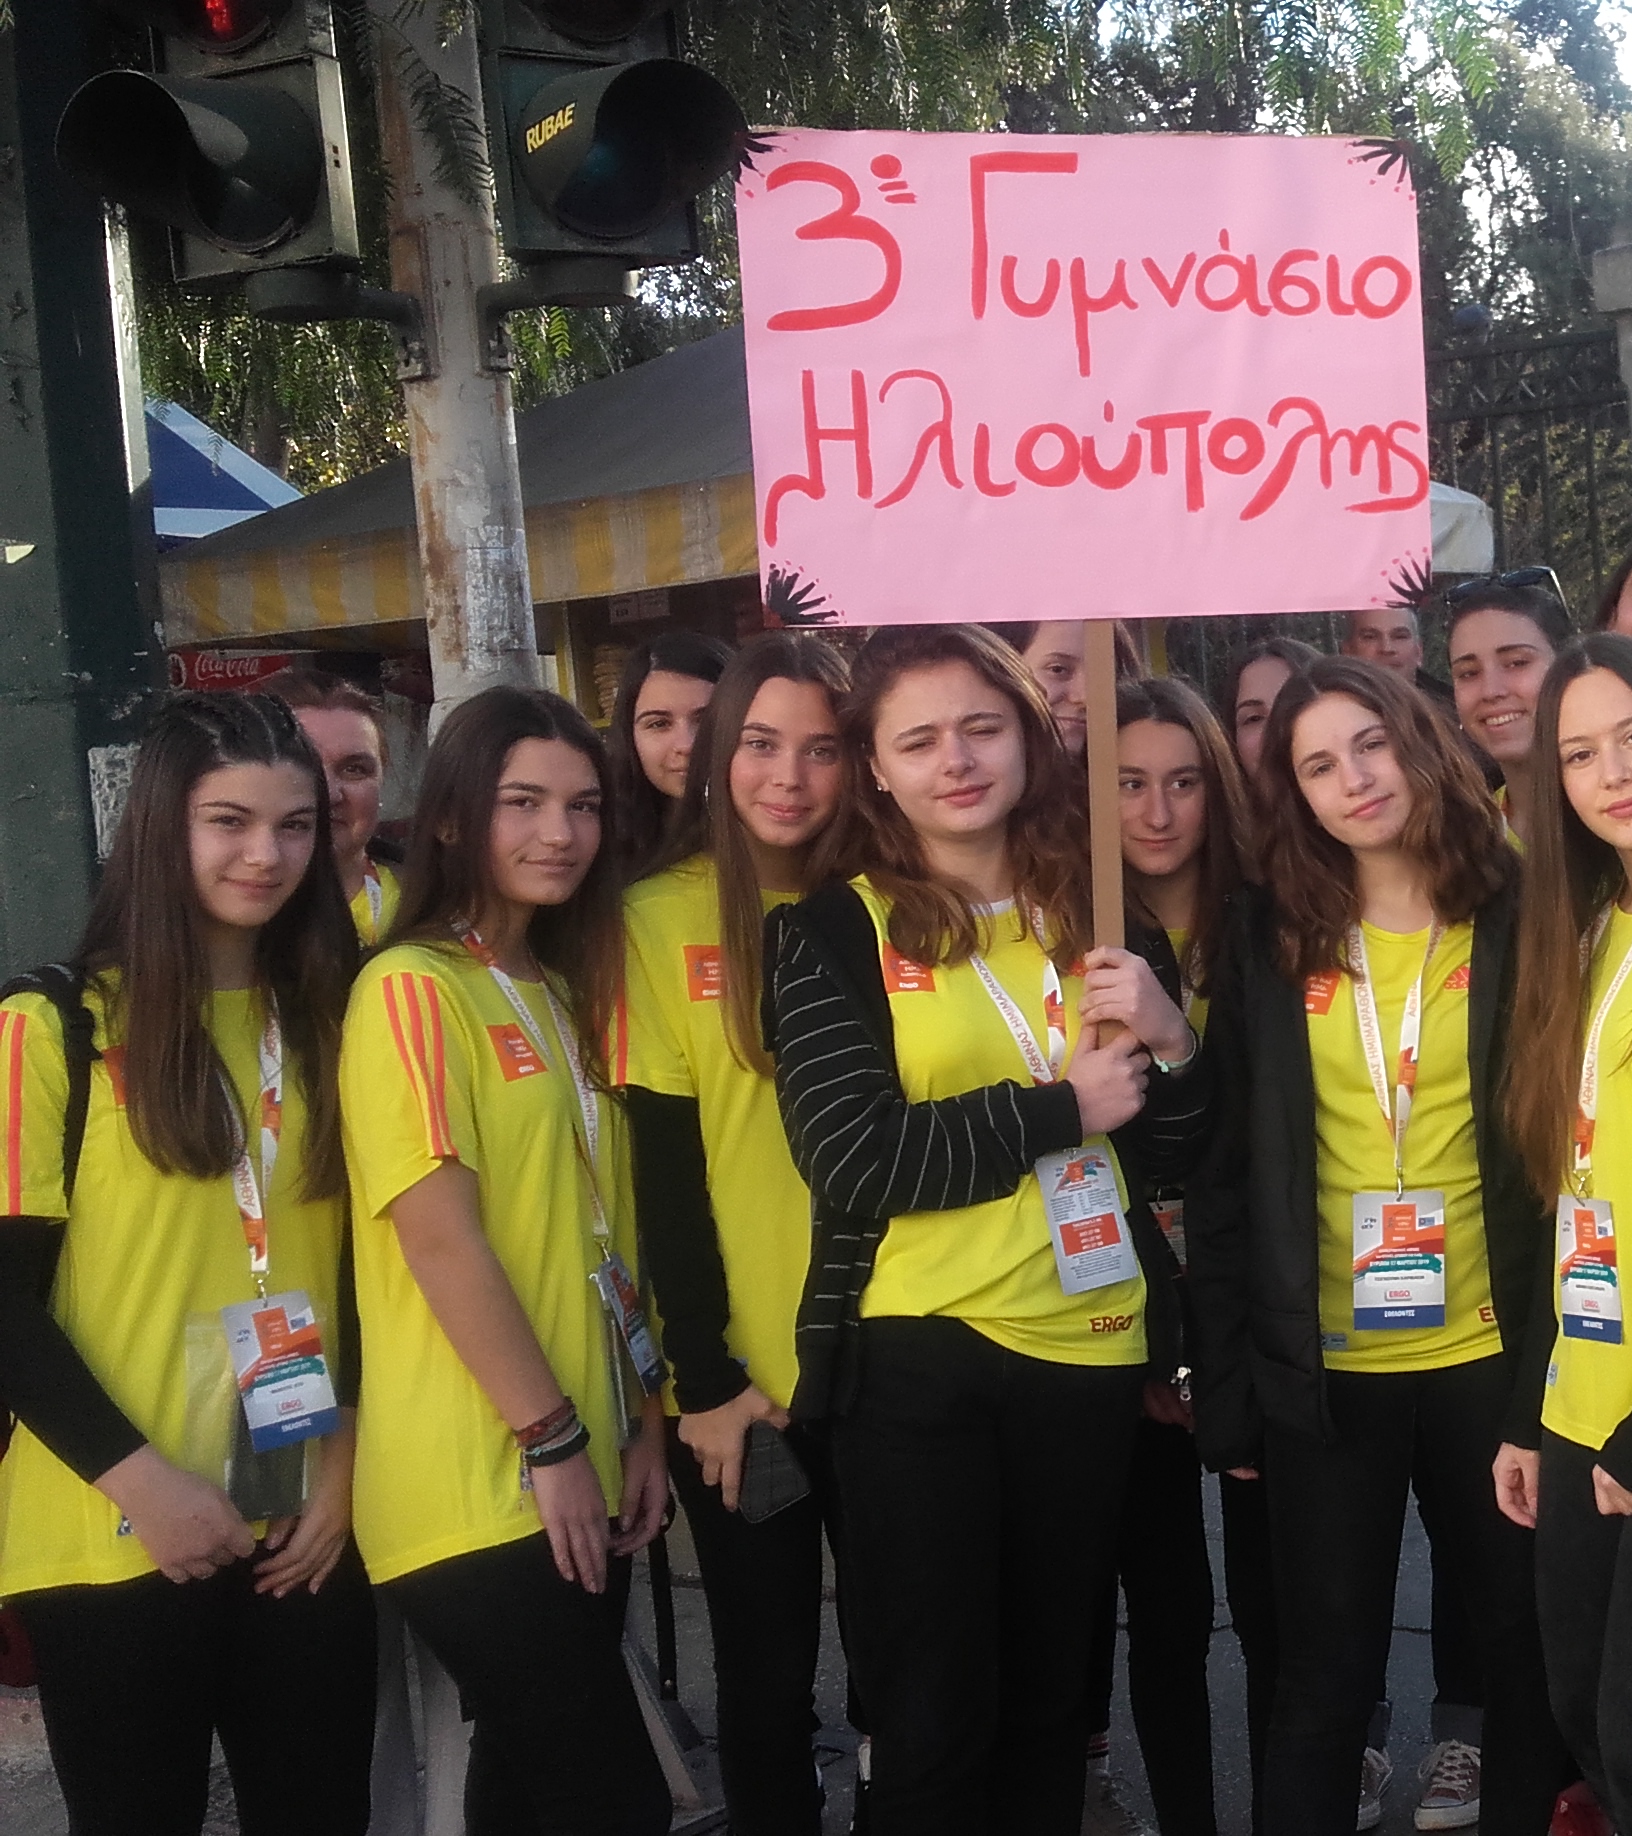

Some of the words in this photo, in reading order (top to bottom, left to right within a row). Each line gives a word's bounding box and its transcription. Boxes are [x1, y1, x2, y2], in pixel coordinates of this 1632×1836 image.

[526, 102, 576, 154] RUBAE
[969, 151, 1413, 378] Γυμνάσιο
[1089, 1314, 1134, 1333] ERGO
